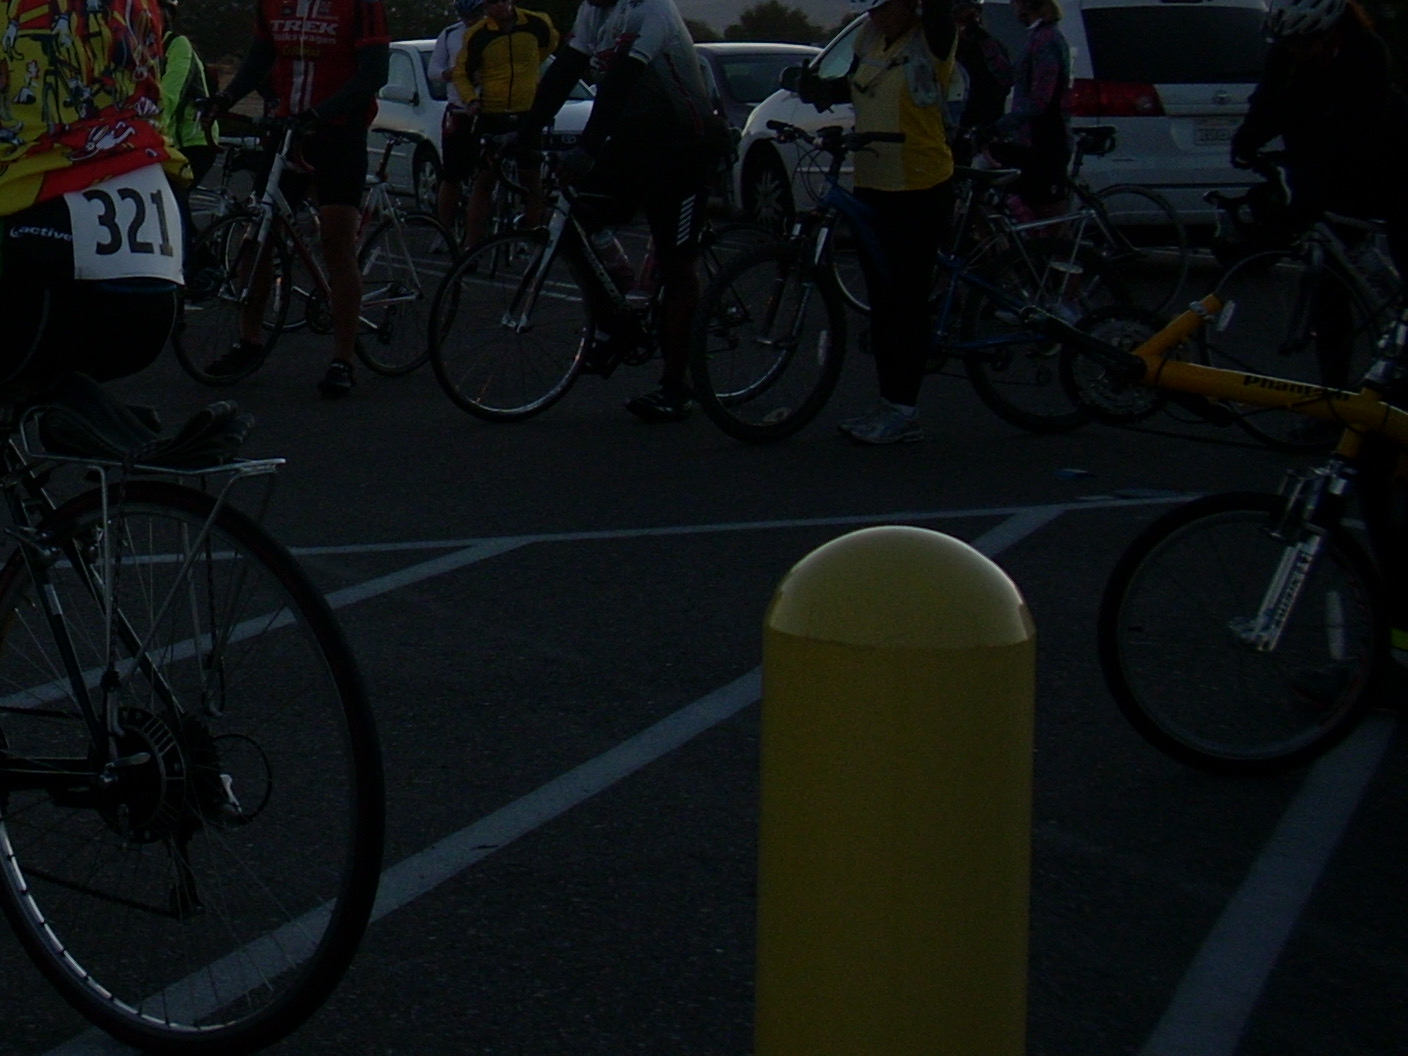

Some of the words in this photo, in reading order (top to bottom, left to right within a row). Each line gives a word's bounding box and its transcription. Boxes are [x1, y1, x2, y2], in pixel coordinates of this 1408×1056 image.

[270, 18, 339, 35] TREK
[83, 188, 174, 257] 321
[1243, 374, 1351, 401] Phantm
